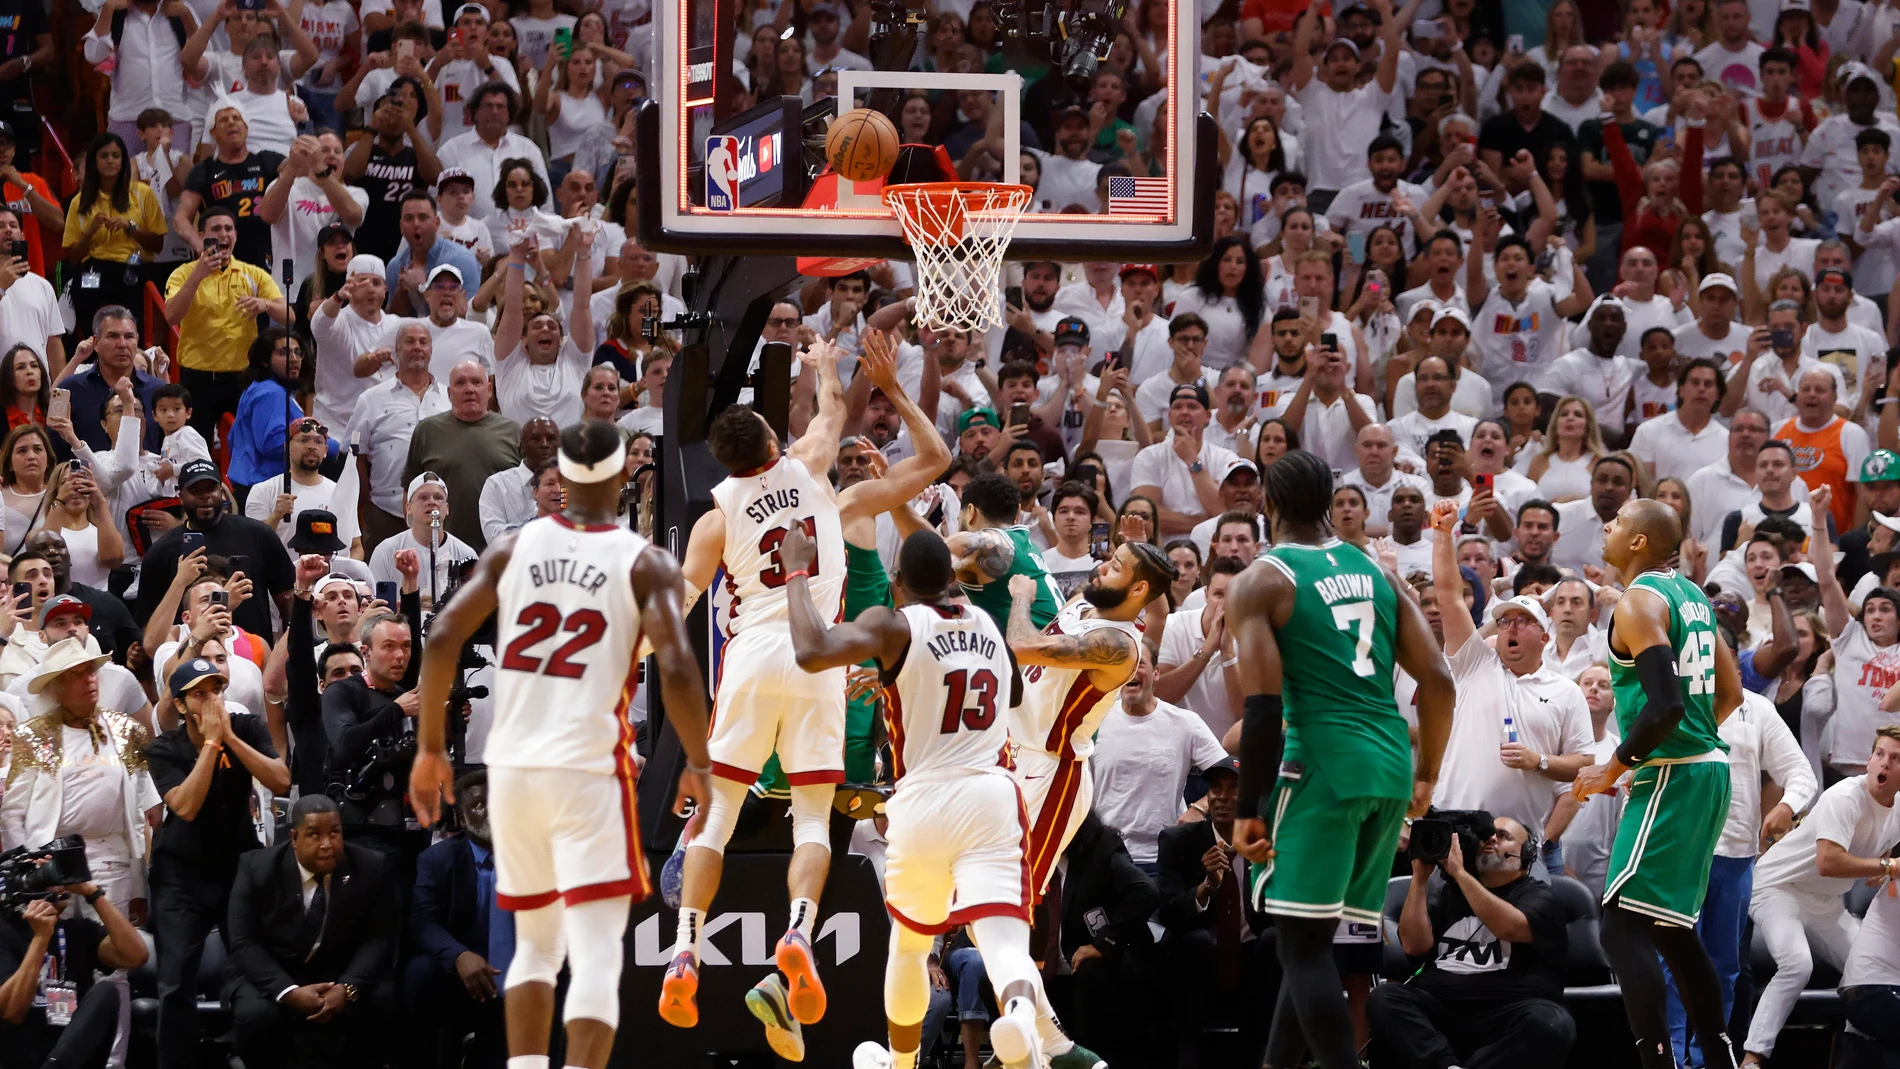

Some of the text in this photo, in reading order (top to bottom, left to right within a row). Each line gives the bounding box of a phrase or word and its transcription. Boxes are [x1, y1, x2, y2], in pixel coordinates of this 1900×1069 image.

[691, 62, 713, 83] TISSOT
[772, 131, 782, 166] TV
[365, 162, 414, 180] MIAMI
[710, 195, 727, 208] NBA
[1360, 202, 1403, 218] HEA
[745, 488, 799, 524] STRUS
[530, 558, 608, 597] BUTLER
[1314, 573, 1375, 606] BROWN
[501, 601, 609, 680] 22
[926, 630, 997, 662] ADEBAYO
[1330, 600, 1376, 678] 7
[1678, 630, 1716, 696] 42
[940, 668, 999, 735] 13
